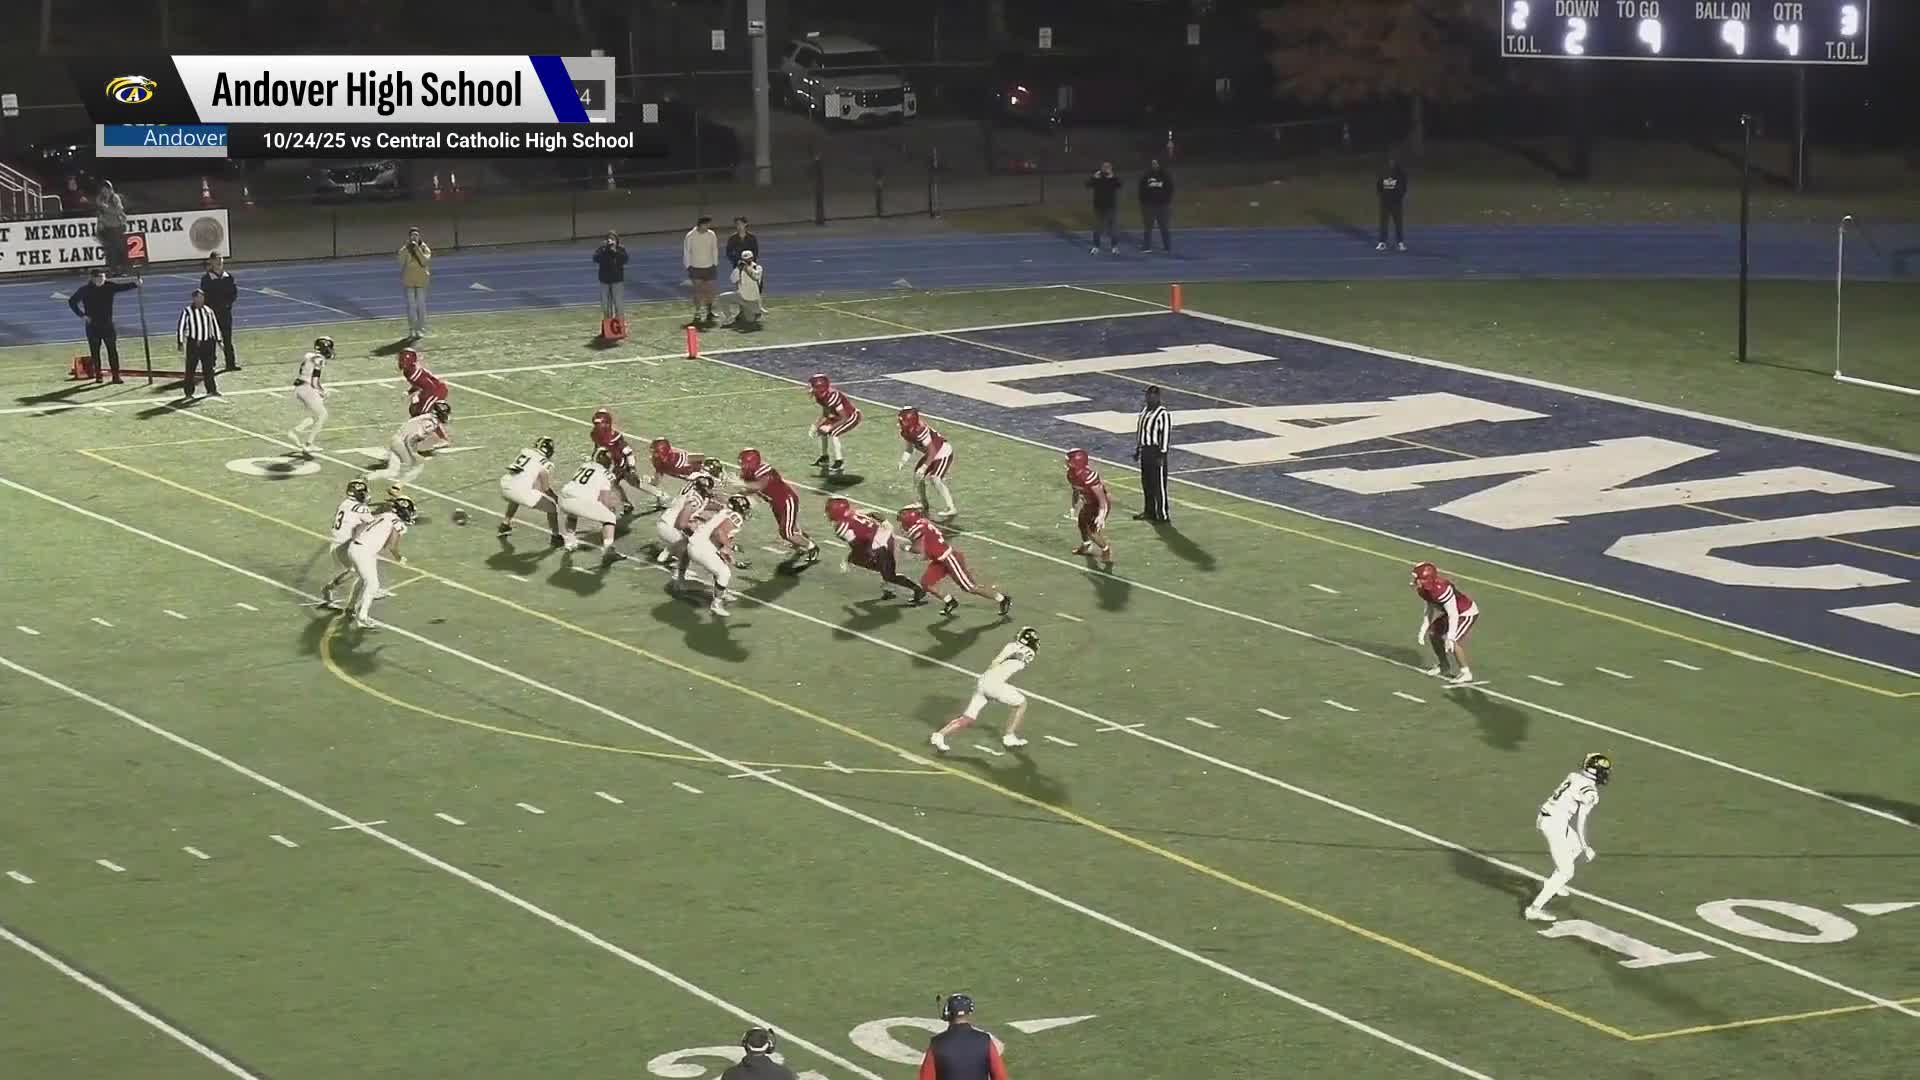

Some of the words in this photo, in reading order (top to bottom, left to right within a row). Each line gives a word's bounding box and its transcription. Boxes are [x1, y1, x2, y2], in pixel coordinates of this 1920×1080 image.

[1555, 0, 1599, 17] DOWN
[1617, 1, 1635, 18] TO
[1640, 2, 1659, 18] GO
[1773, 3, 1802, 21] QTR
[1507, 36, 1541, 53] T.O.L.
[1565, 17, 1587, 55] 2
[1639, 19, 1662, 53] 9
[1722, 20, 1745, 55] 9
[1776, 24, 1799, 56] 4
[1826, 42, 1863, 59] T.O.L.
[25, 222, 97, 241] MEMORI
[126, 217, 184, 234] TRACK
[17, 249, 51, 266] THE
[59, 245, 104, 263] LANC
[127, 236, 146, 259] 2
[610, 319, 622, 335] G
[1537, 898, 1858, 968] 10
